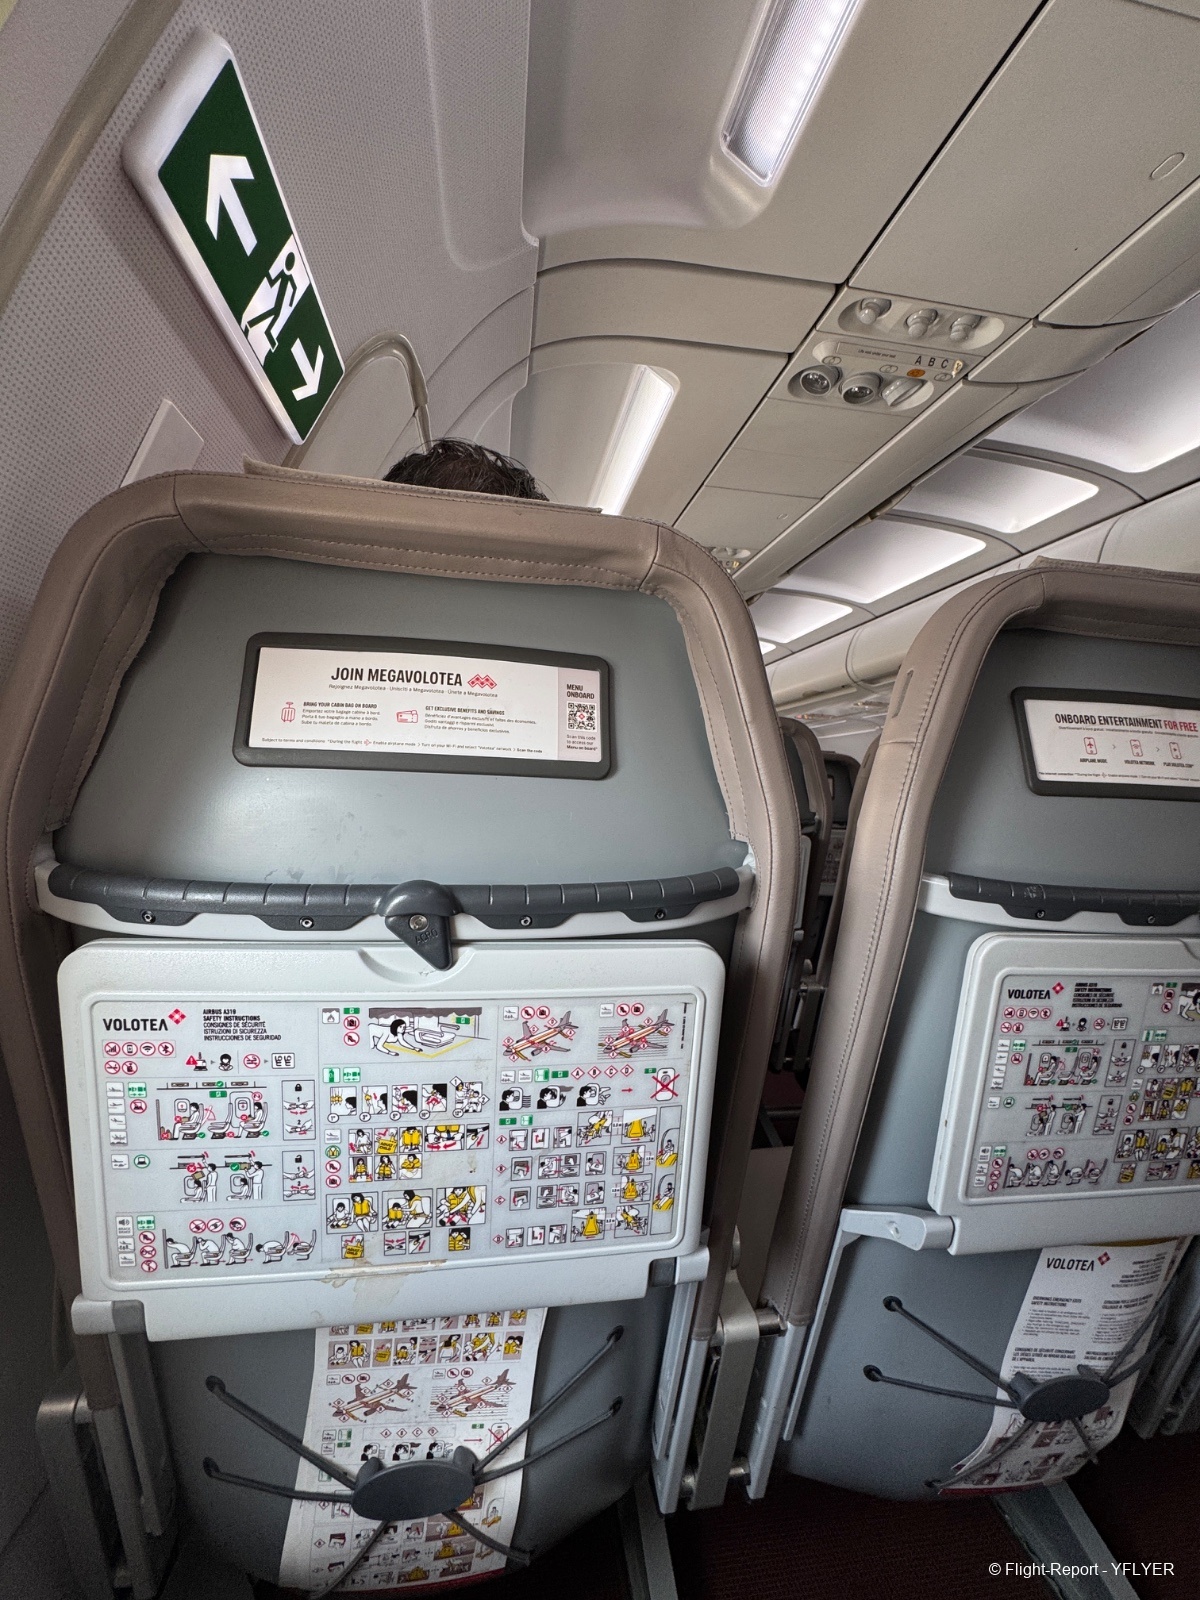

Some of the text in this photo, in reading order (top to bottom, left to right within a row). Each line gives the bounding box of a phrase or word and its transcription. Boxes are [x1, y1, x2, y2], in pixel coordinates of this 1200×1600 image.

[915, 356, 949, 368] A B C
[331, 667, 463, 686] JOIN MEGAVOLOTEA
[566, 691, 595, 699] ONBOARD
[1055, 713, 1096, 725] ONBOARD
[1098, 715, 1164, 729] ENTERTAINMENT
[1164, 720, 1178, 731] FOR
[1179, 721, 1198, 732] FREE
[1008, 989, 1051, 999] VOLOTEA
[103, 1018, 168, 1031] VOLOTEA
[1046, 1258, 1094, 1271] VOLOTEA
